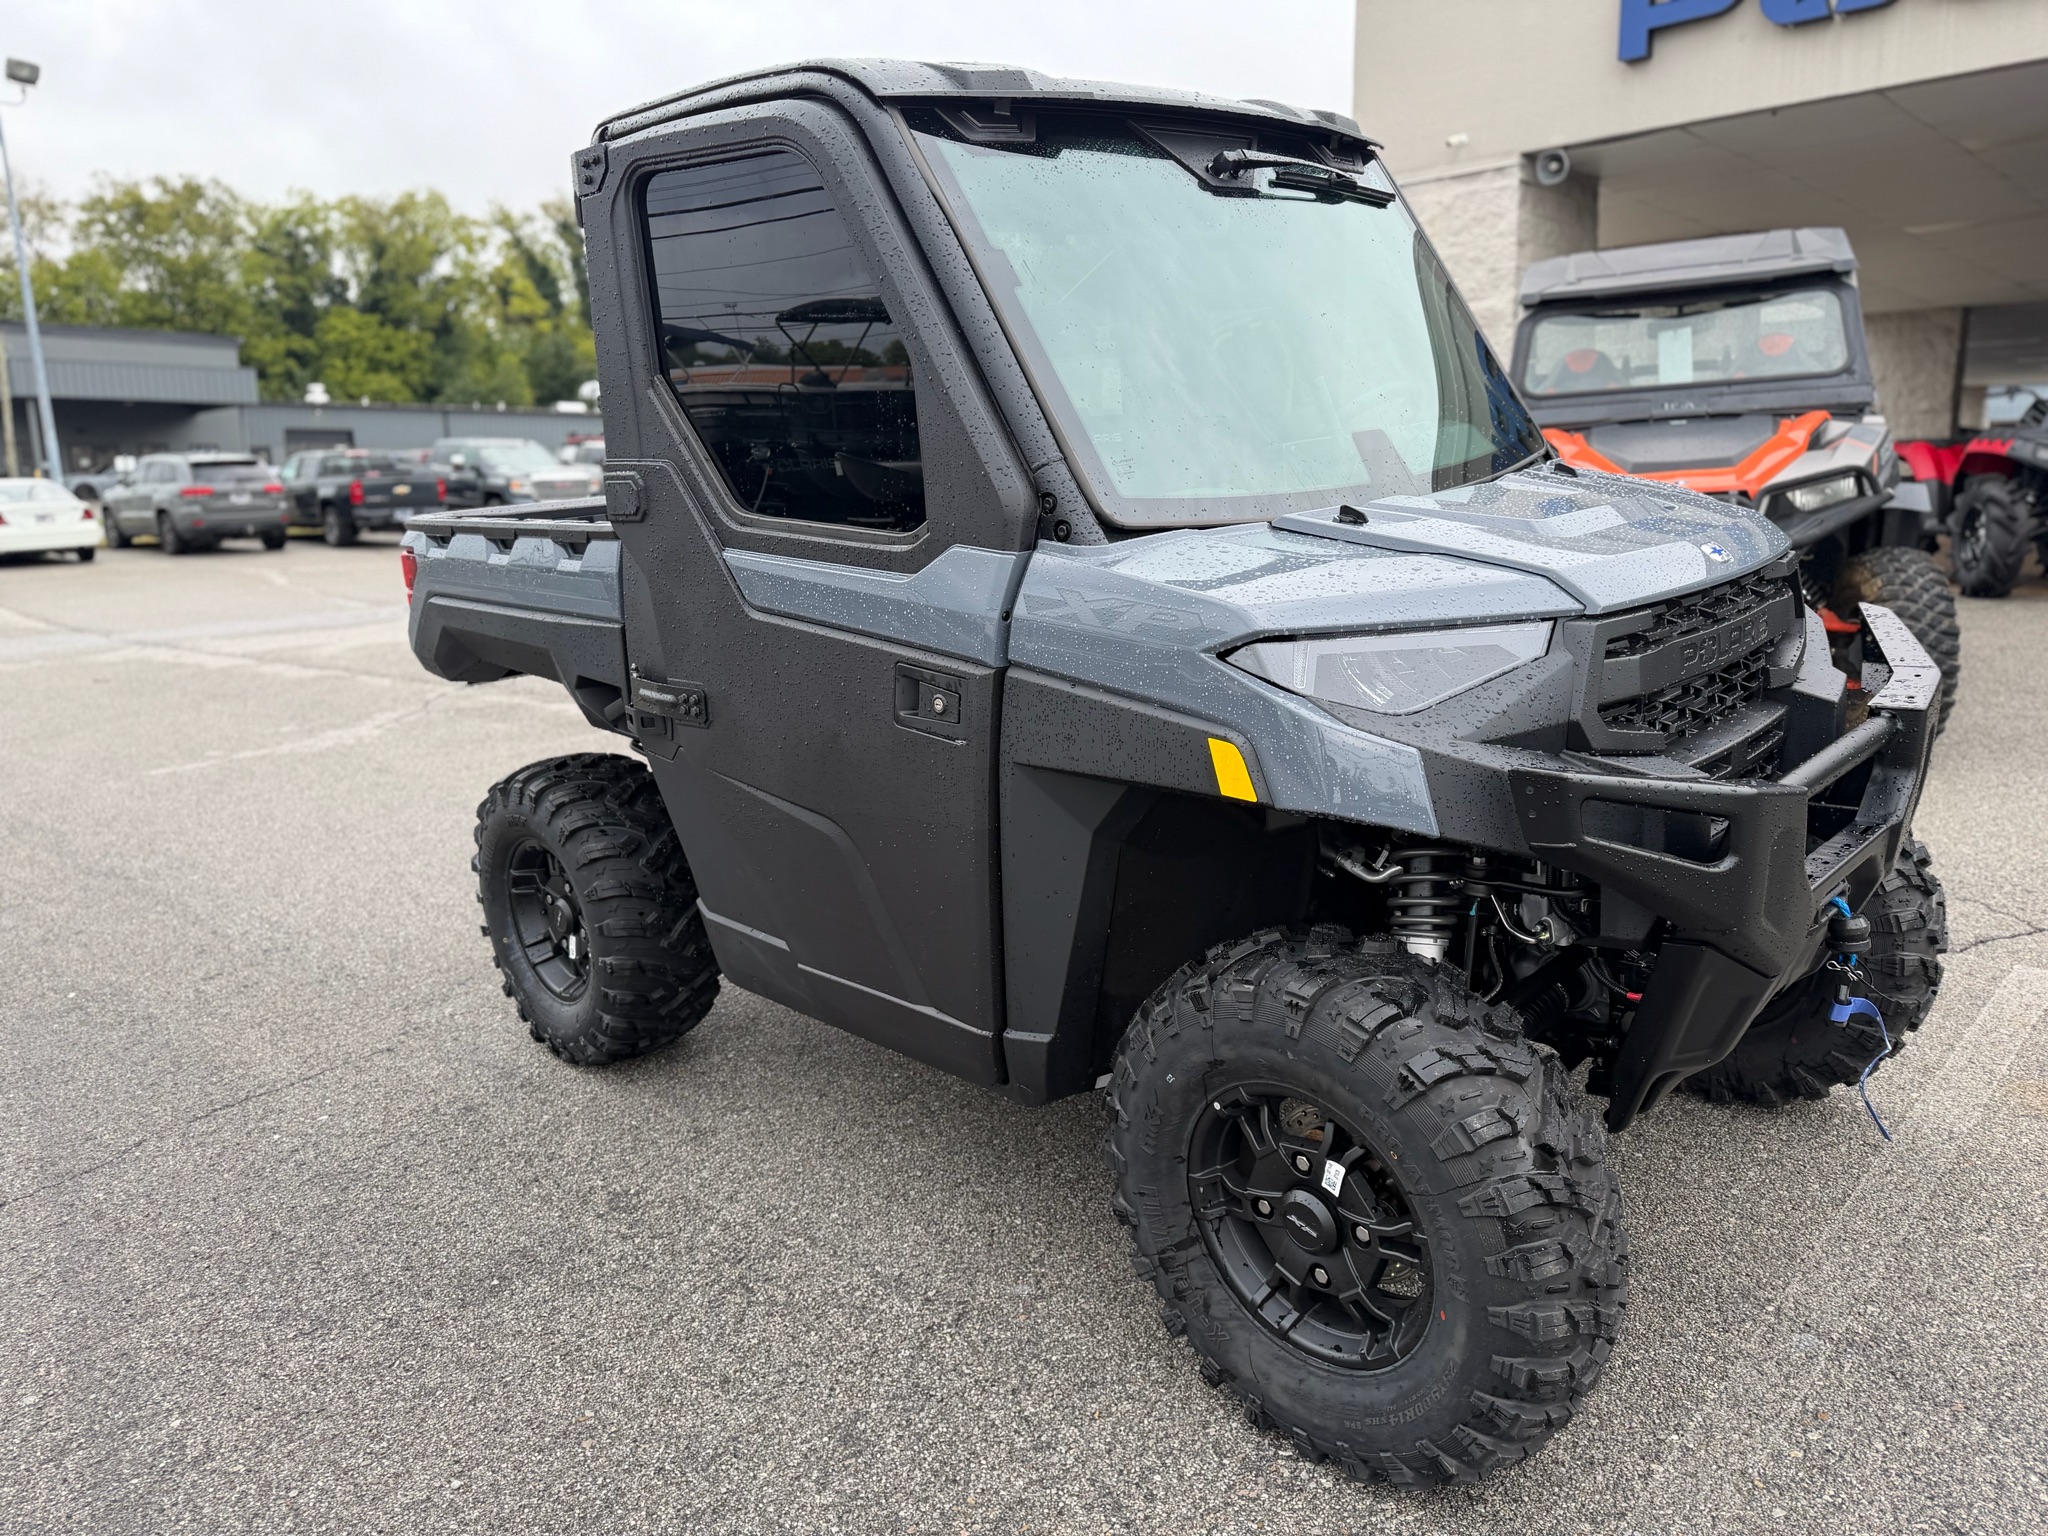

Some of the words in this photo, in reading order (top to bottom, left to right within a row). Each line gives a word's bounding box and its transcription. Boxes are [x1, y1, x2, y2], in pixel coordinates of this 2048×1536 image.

[1093, 432, 1122, 443] ARIS
[776, 458, 837, 471] OLARIS
[1679, 613, 1769, 674] POLARIS
